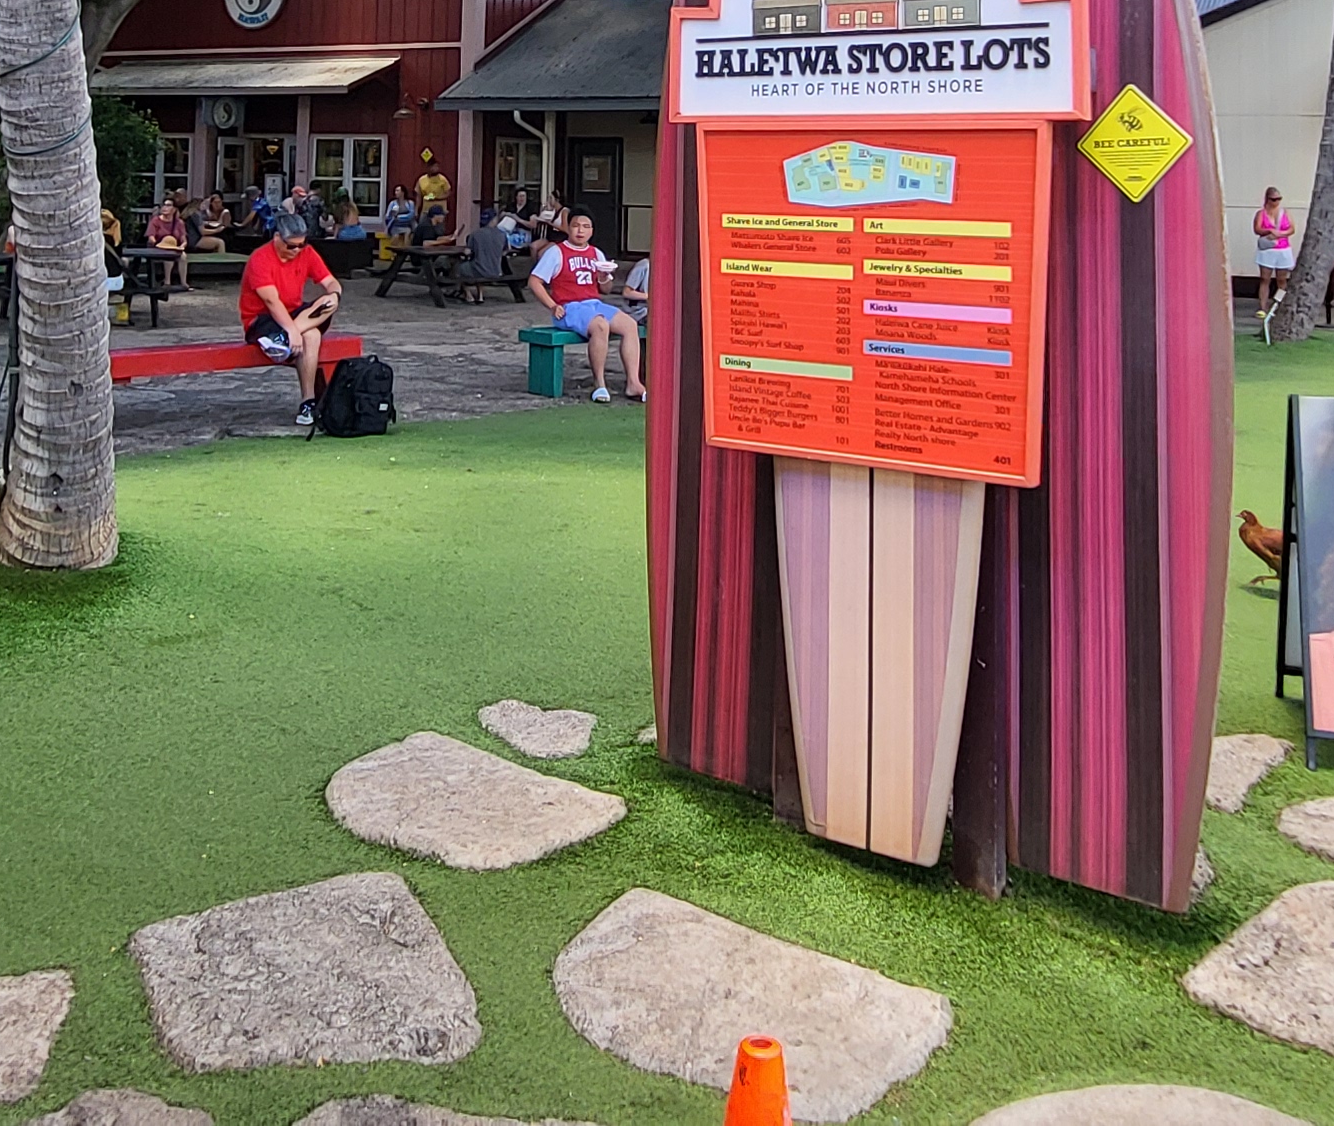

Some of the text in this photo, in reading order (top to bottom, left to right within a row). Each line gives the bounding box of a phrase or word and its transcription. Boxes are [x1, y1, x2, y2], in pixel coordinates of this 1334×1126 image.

[847, 40, 954, 74] STORE
[960, 36, 1051, 71] LOTS
[751, 78, 984, 97] HEART OF THE NORTH SHORE
[1093, 137, 1170, 149] BEE CAREFUL!
[726, 216, 838, 228] Shave Ice and General Store
[869, 220, 883, 230] Art
[802, 233, 814, 242] Ice
[763, 242, 794, 251] General
[795, 243, 817, 252] Store
[896, 247, 927, 258] Gallery
[569, 256, 596, 273] BULLS
[726, 262, 773, 273] Island Wear
[869, 262, 963, 276] Jewelry & Specialties
[898, 278, 926, 288] Divers
[836, 297, 851, 305] 502
[836, 306, 850, 315] 501
[869, 302, 898, 313] Kiosks
[836, 317, 851, 325] 202
[836, 327, 851, 335] 203
[875, 328, 905, 338] Moana
[907, 330, 937, 341] Woods
[868, 343, 905, 354] Services
[724, 357, 751, 369] Dining
[878, 371, 977, 387] Kamehameha Schools
[729, 384, 850, 404] Island Vintage Coffee 503
[836, 385, 849, 394] 701
[875, 381, 1016, 402] North Shore Information Center
[761, 397, 778, 406] Thai
[831, 405, 850, 414] 1001
[875, 393, 1011, 415] Management Office 301
[729, 404, 758, 414] Teddy's
[759, 407, 786, 418] Bigger
[787, 409, 818, 422] Burgers
[728, 413, 751, 423] Uncle
[792, 420, 806, 430] Bar
[875, 408, 1011, 432] Better Homes and Gardens 902
[737, 424, 744, 432] &
[875, 419, 893, 428] Real
[895, 421, 922, 432] Estate
[929, 424, 979, 440] Advantage
[835, 436, 849, 445] 101
[875, 429, 957, 447] Realty North shore
[875, 440, 923, 454] Restrooms
[993, 455, 1011, 466] 401
